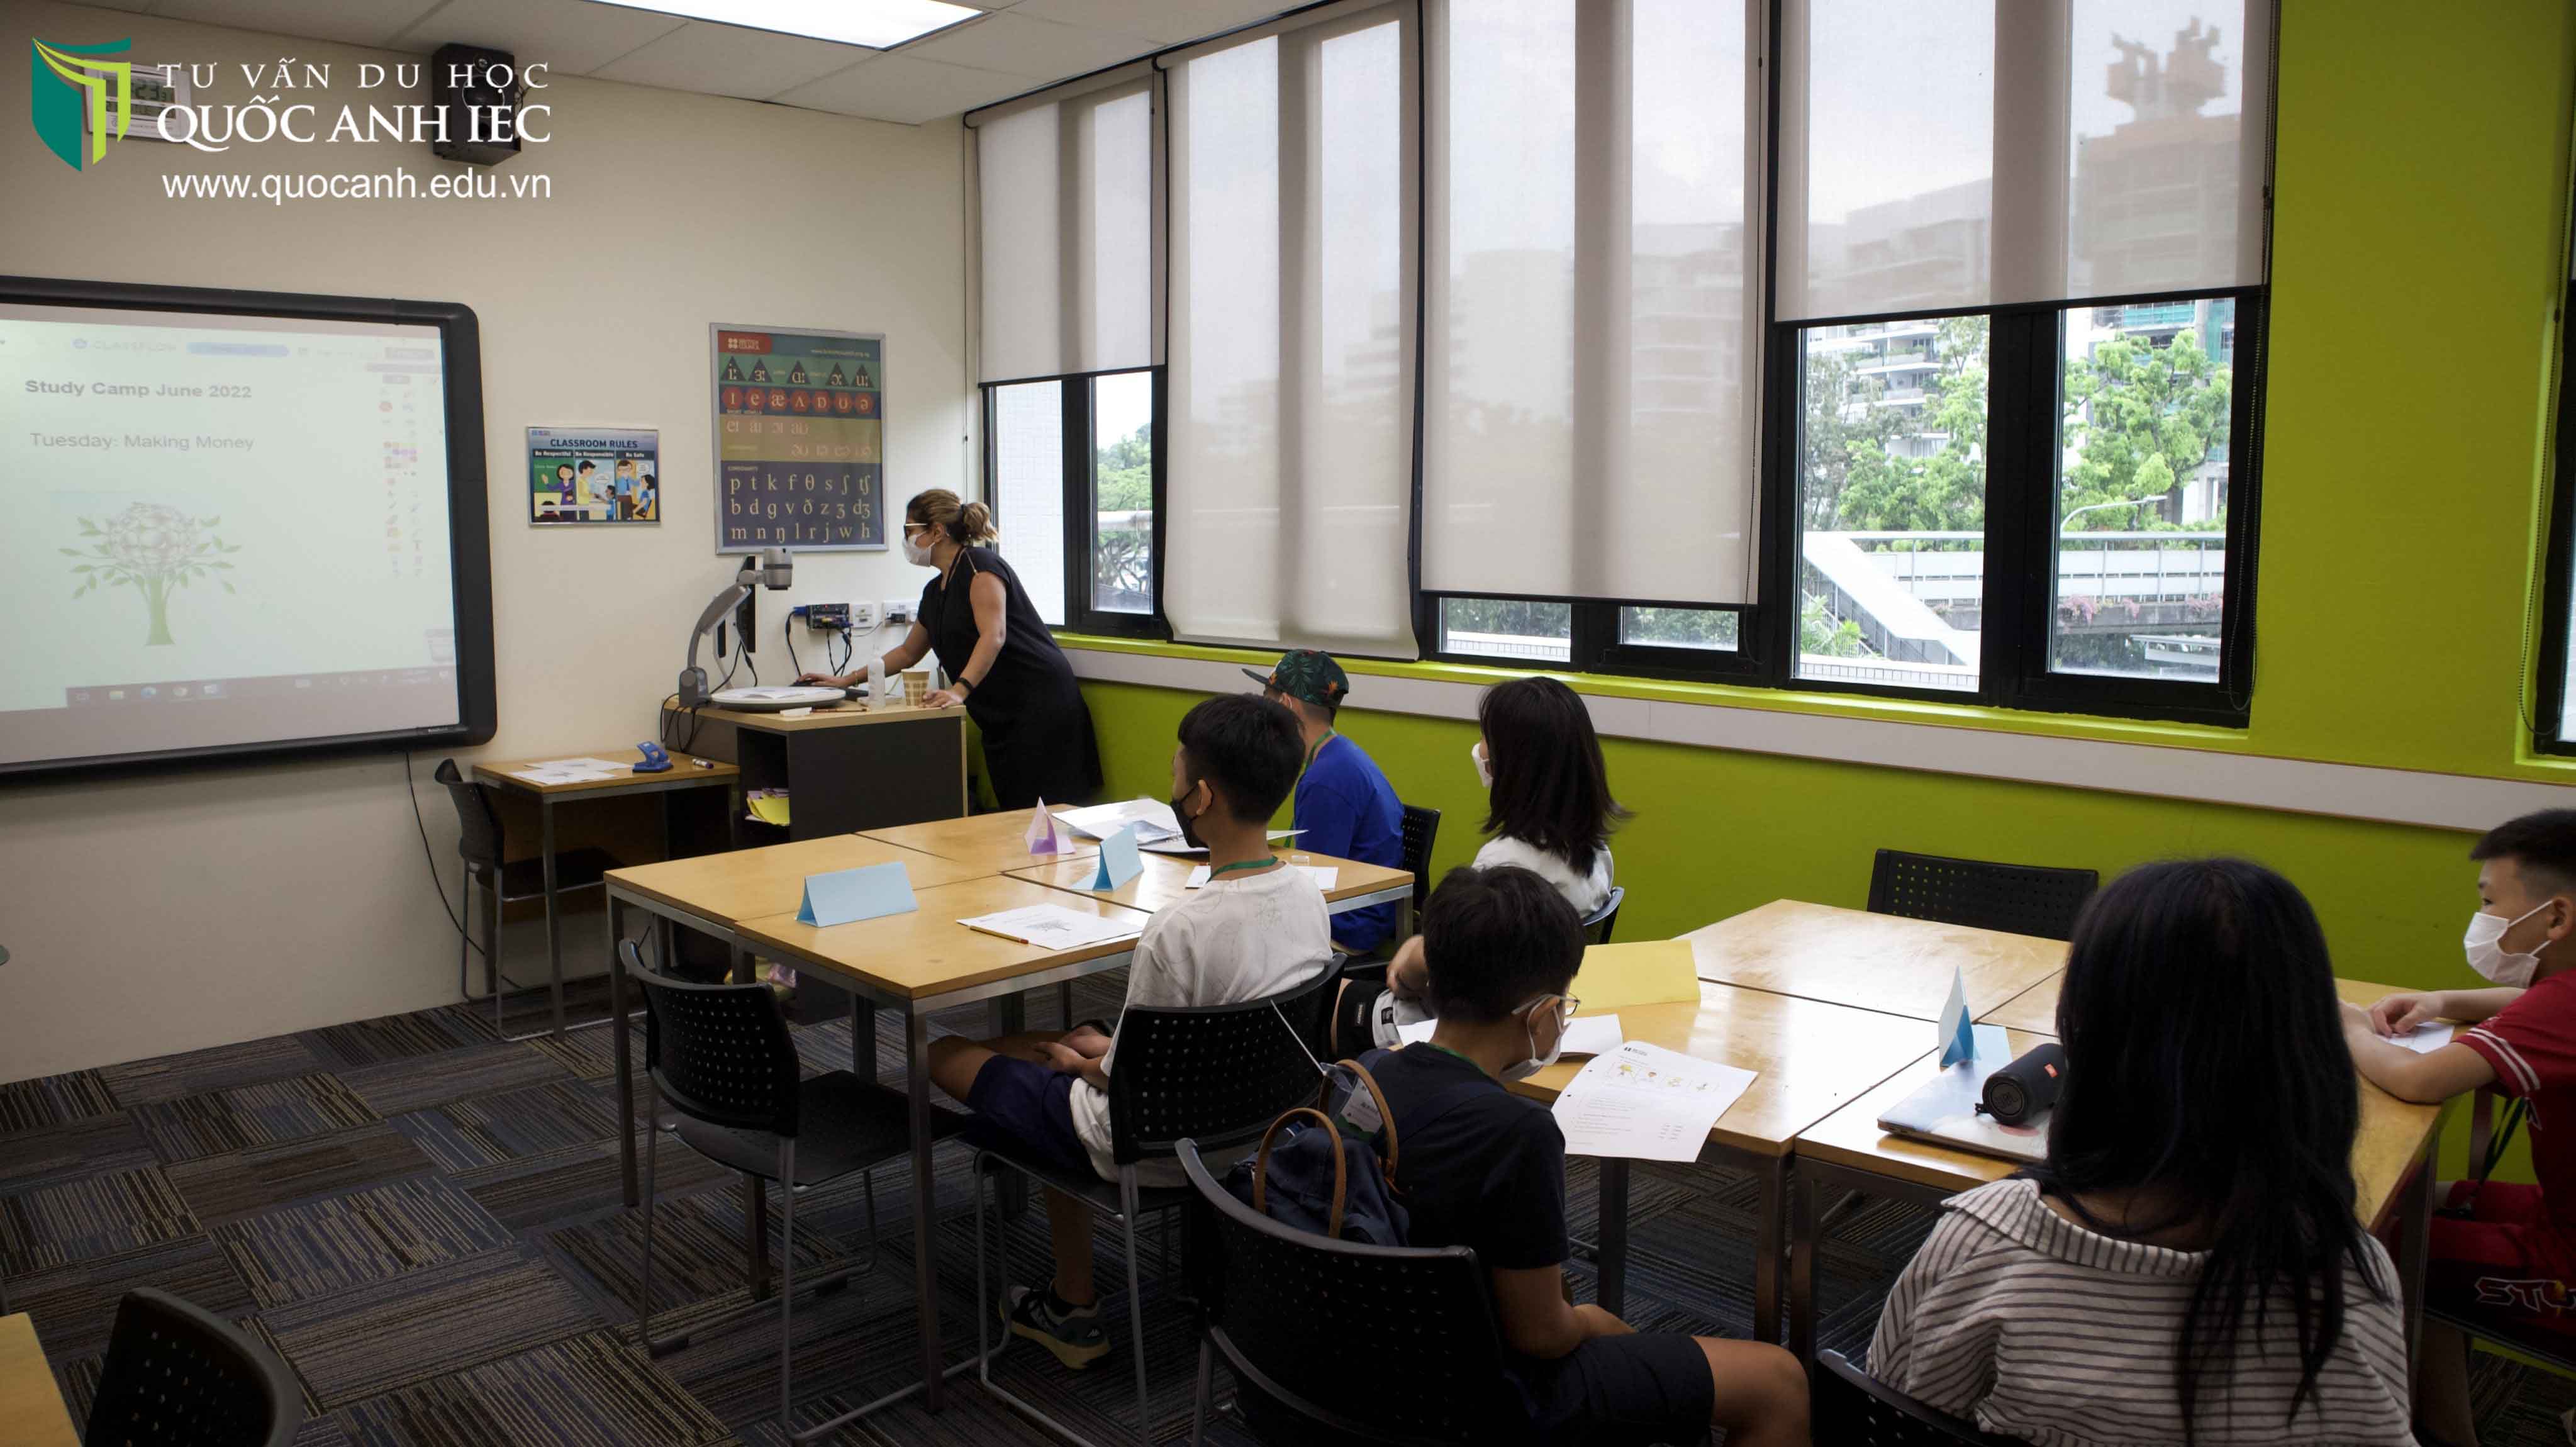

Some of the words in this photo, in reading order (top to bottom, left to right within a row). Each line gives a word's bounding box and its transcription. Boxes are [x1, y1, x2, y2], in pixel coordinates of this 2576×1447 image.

[25, 380, 85, 397] Study
[91, 381, 150, 398] Camp
[155, 383, 203, 398] June
[209, 384, 252, 398] 2022
[124, 433, 189, 451] Making
[195, 435, 255, 452] Money
[550, 439, 607, 448] CLASSROOM
[609, 440, 638, 449] RULES
